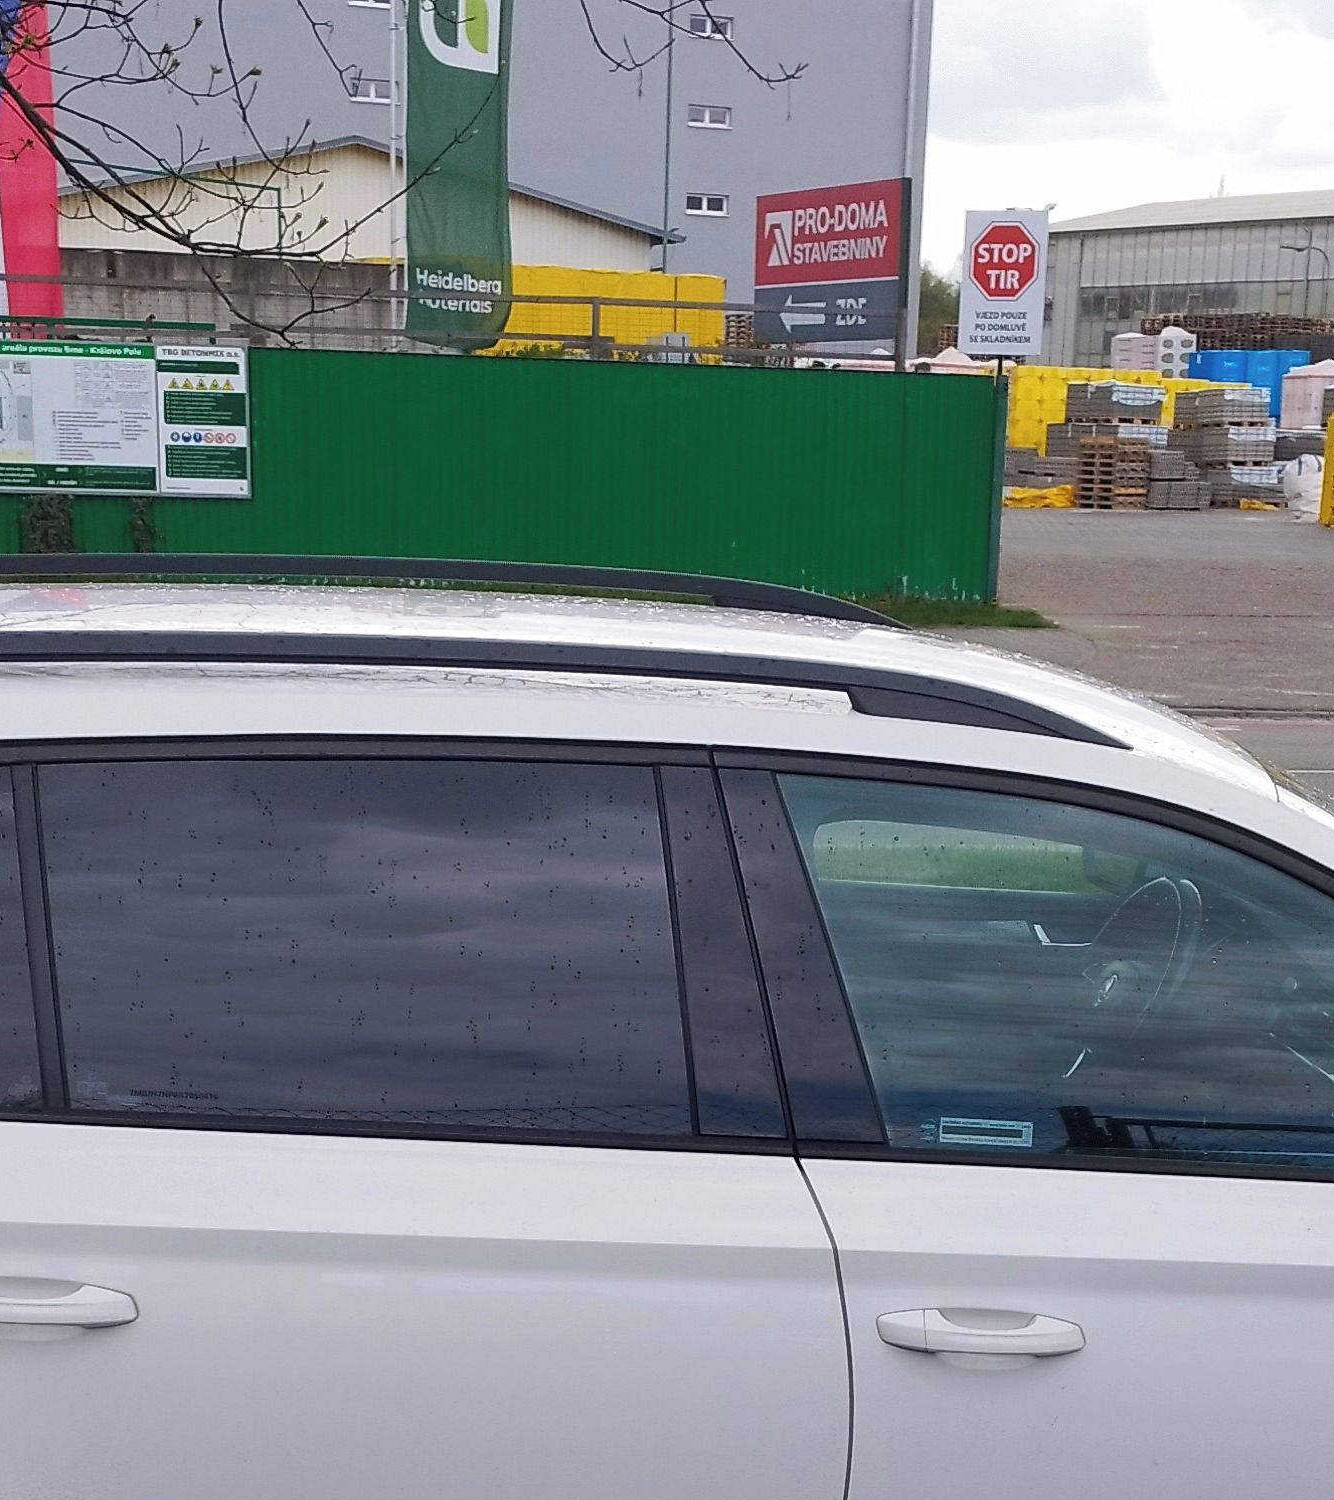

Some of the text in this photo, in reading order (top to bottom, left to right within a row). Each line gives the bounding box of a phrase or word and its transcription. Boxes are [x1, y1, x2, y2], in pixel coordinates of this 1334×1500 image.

[793, 199, 889, 236] PRO-DOMA
[793, 235, 888, 266] STAVEBNINY
[977, 243, 1033, 264] STOP
[415, 267, 502, 295] Heidelberg
[986, 269, 1020, 290] TIR
[975, 323, 986, 331] PO
